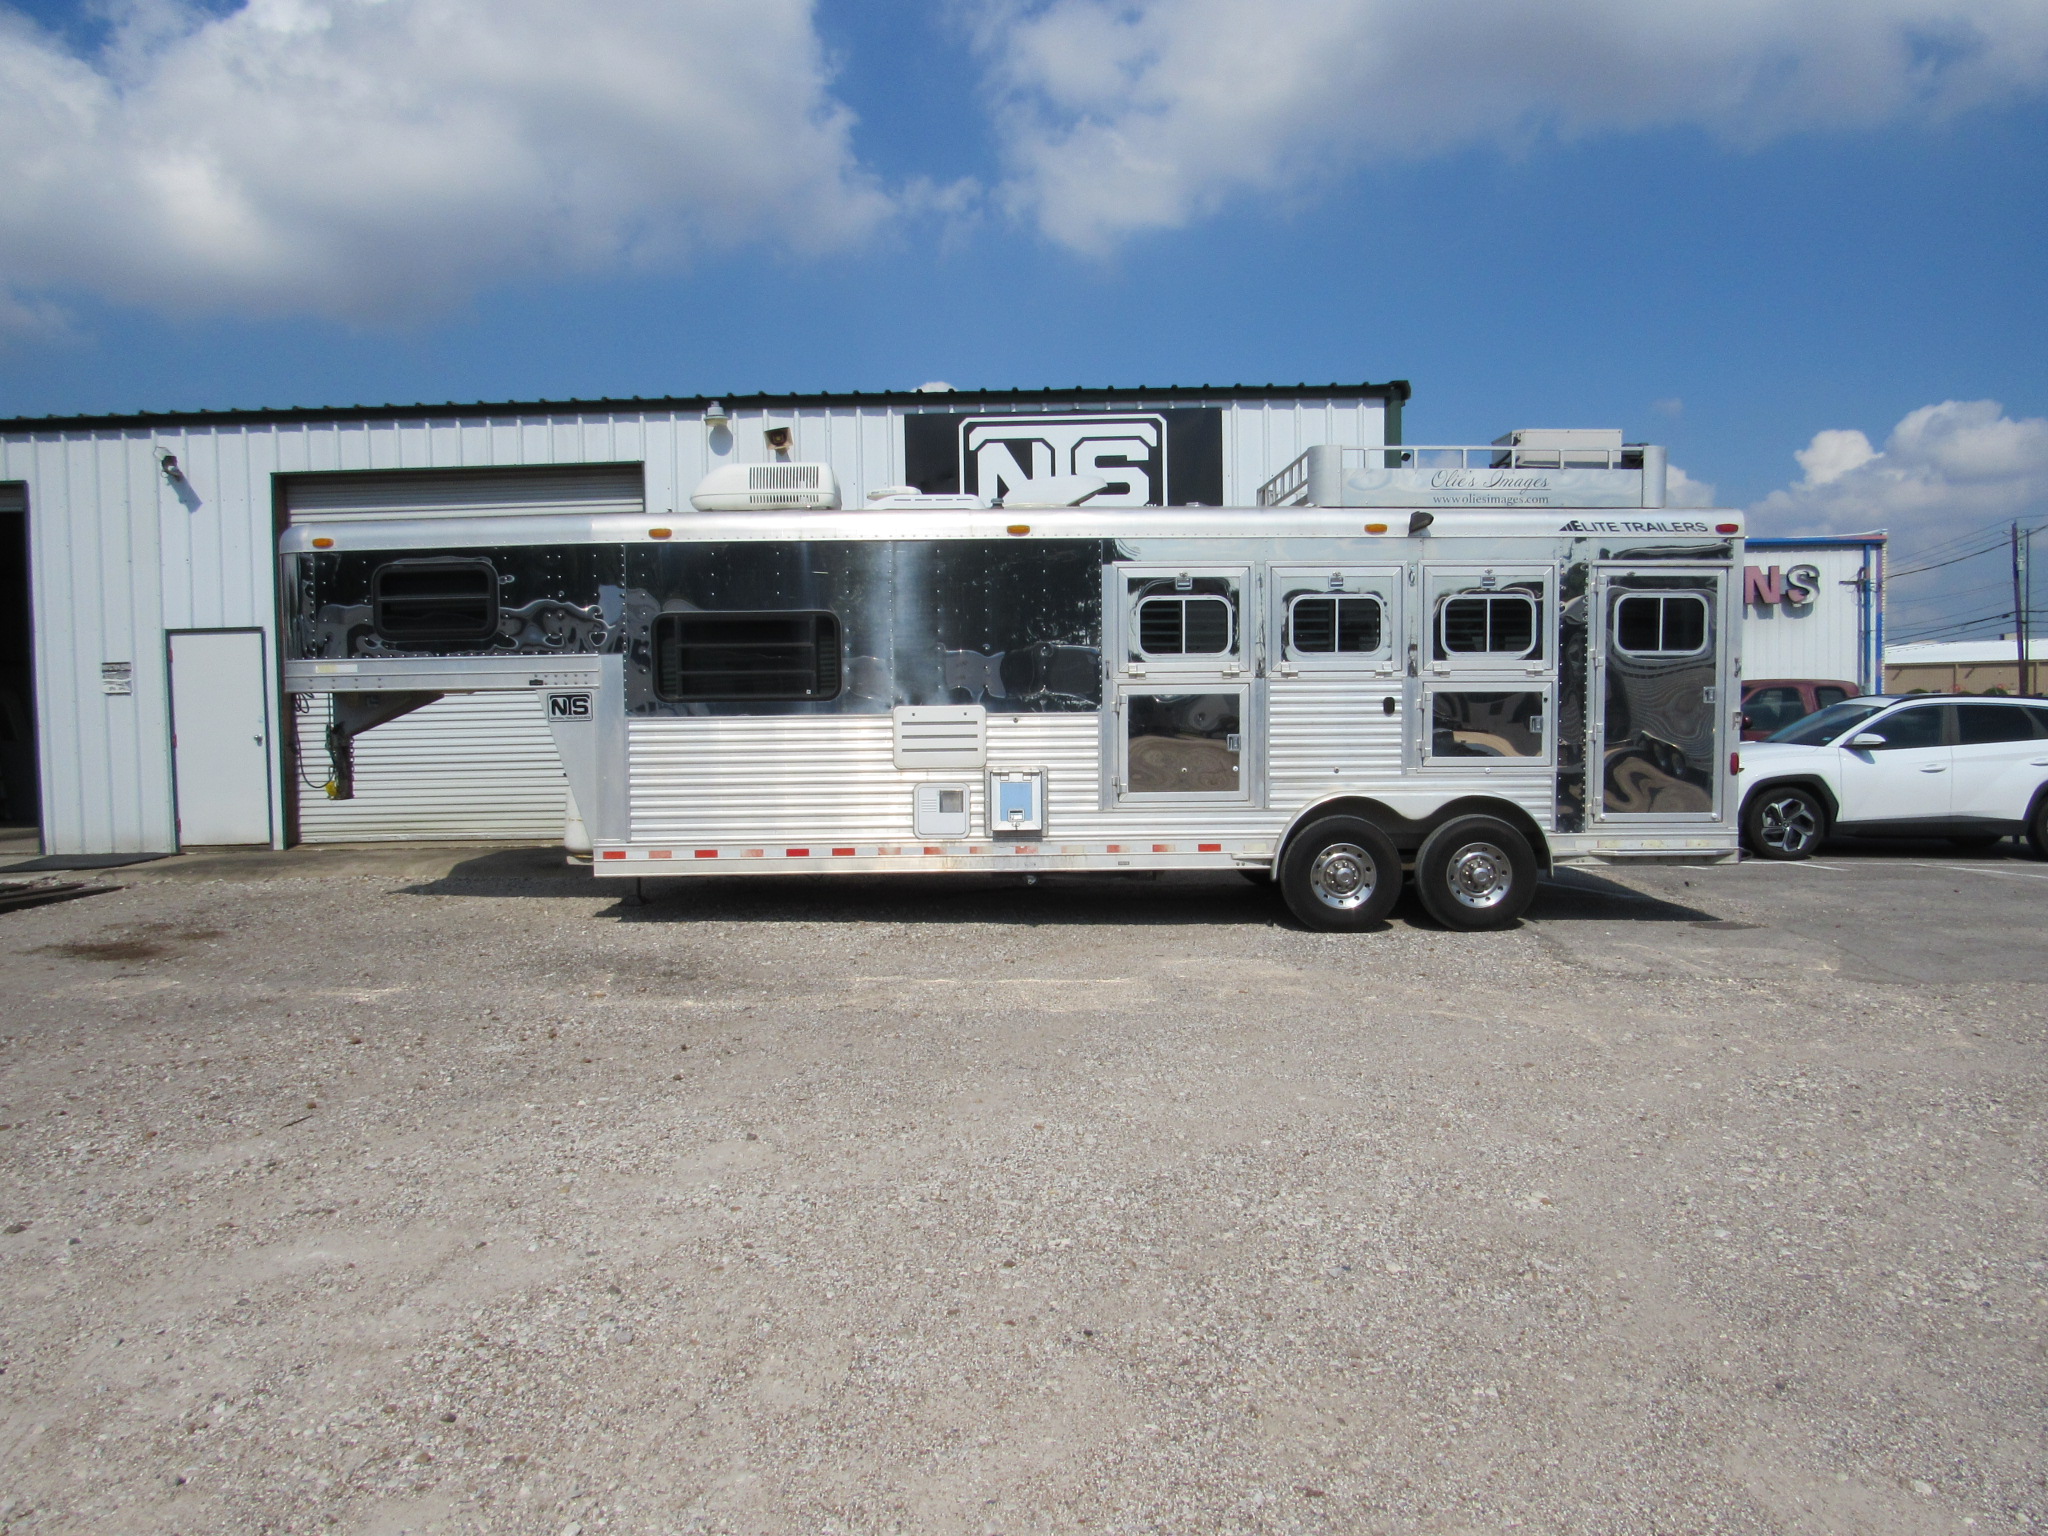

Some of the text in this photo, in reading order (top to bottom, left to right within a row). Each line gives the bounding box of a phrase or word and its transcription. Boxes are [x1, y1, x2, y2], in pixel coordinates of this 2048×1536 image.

[1482, 469, 1550, 495] Images
[1432, 493, 1549, 506] wwwoliesimages.com
[1560, 520, 1708, 532] ELITE TRAILERS
[550, 694, 590, 716] NTS
